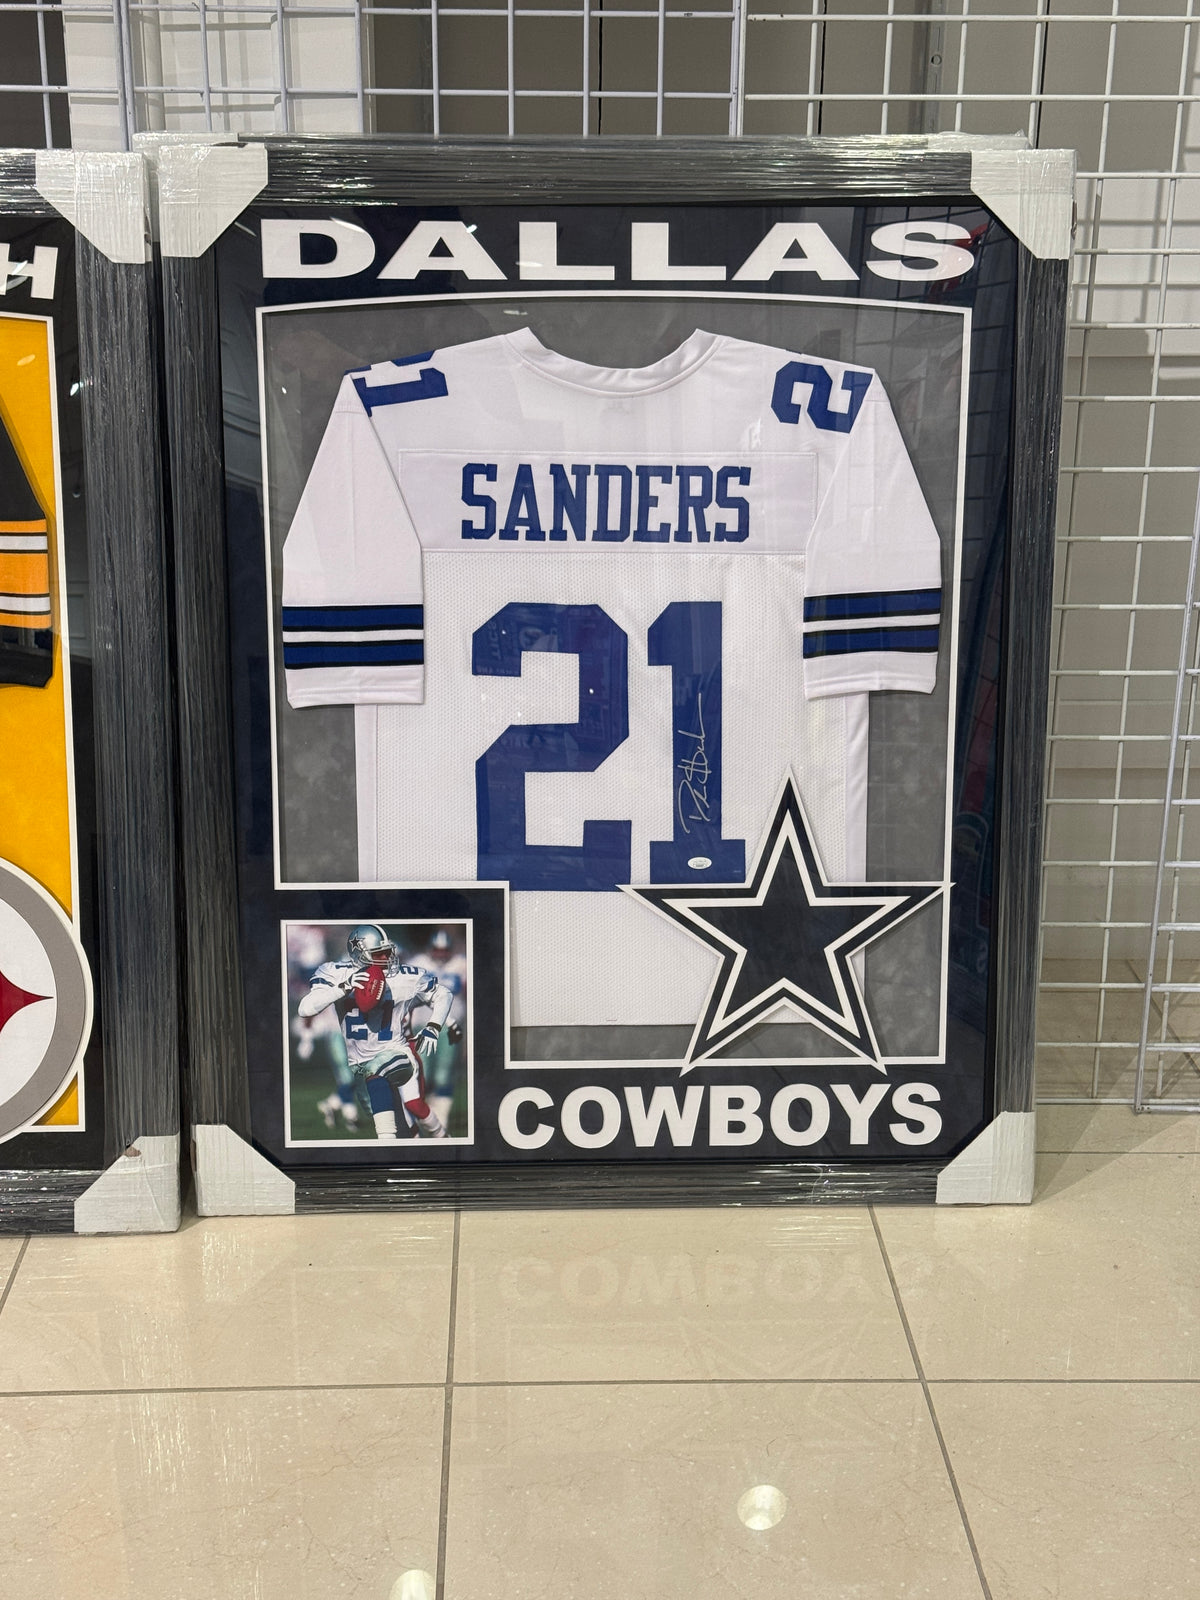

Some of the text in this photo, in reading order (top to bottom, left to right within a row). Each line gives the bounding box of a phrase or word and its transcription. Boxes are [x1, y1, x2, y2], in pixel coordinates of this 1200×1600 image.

[261, 219, 975, 282] DALLAS
[771, 360, 874, 434] 2
[461, 463, 752, 543] SANDERS
[472, 600, 746, 893] 21
[498, 1083, 943, 1149] COWBOYS
